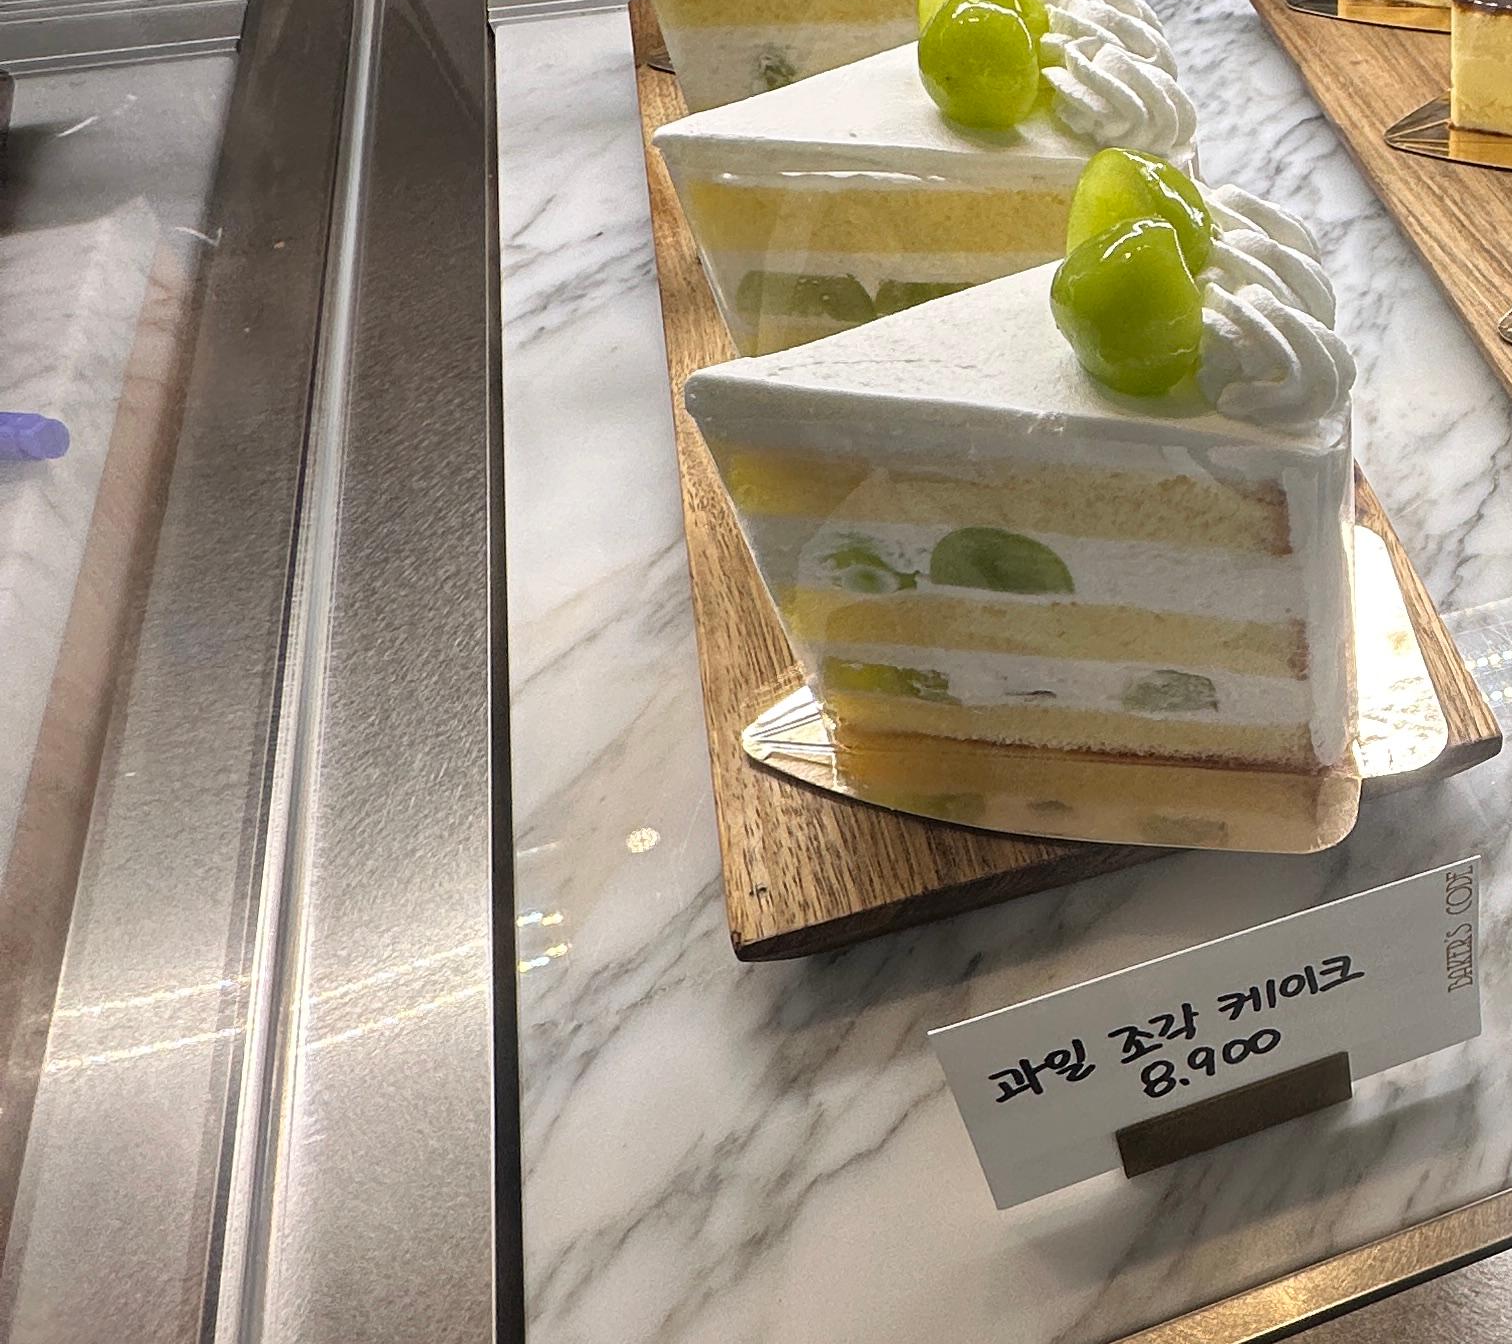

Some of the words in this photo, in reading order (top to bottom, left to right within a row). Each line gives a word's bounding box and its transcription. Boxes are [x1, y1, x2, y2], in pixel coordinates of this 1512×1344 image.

[1445, 864, 1474, 916] CODE
[1443, 922, 1473, 994] BAKER'S
[987, 1038, 1097, 1103] 과일
[1107, 1002, 1200, 1065] 조각
[1216, 955, 1365, 1021] 케이크
[1140, 1028, 1281, 1099] 8.900
